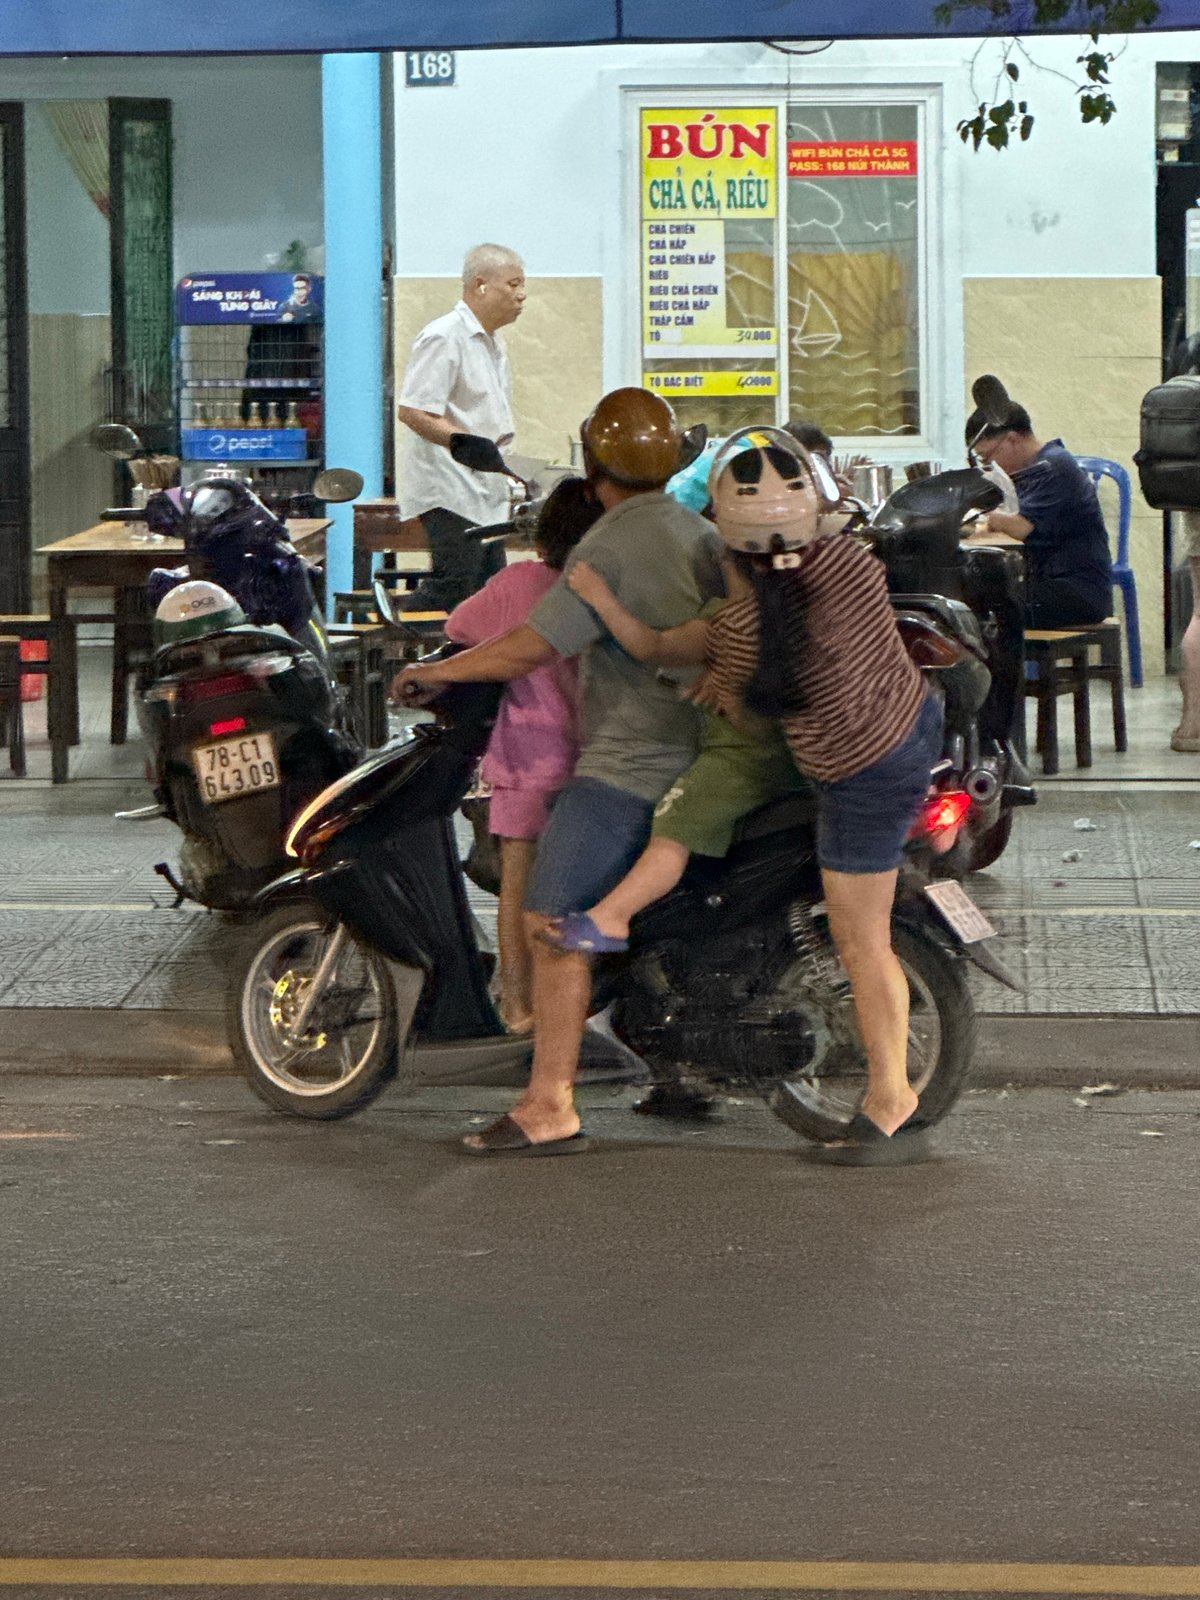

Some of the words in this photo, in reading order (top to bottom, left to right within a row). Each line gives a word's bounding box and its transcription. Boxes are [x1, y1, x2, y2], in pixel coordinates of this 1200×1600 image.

[409, 53, 452, 79] 168
[646, 113, 771, 159] BÚN
[789, 161, 824, 171] PASS:
[826, 161, 846, 171] 168
[791, 148, 817, 158] WIFI
[891, 148, 908, 158] 5G
[649, 166, 687, 210] CHẢ
[691, 169, 721, 216] CÁ,
[726, 169, 769, 209] RIÊU
[228, 434, 273, 451] pepsi
[206, 739, 262, 771] 78-C1
[205, 761, 275, 798] 643.09
